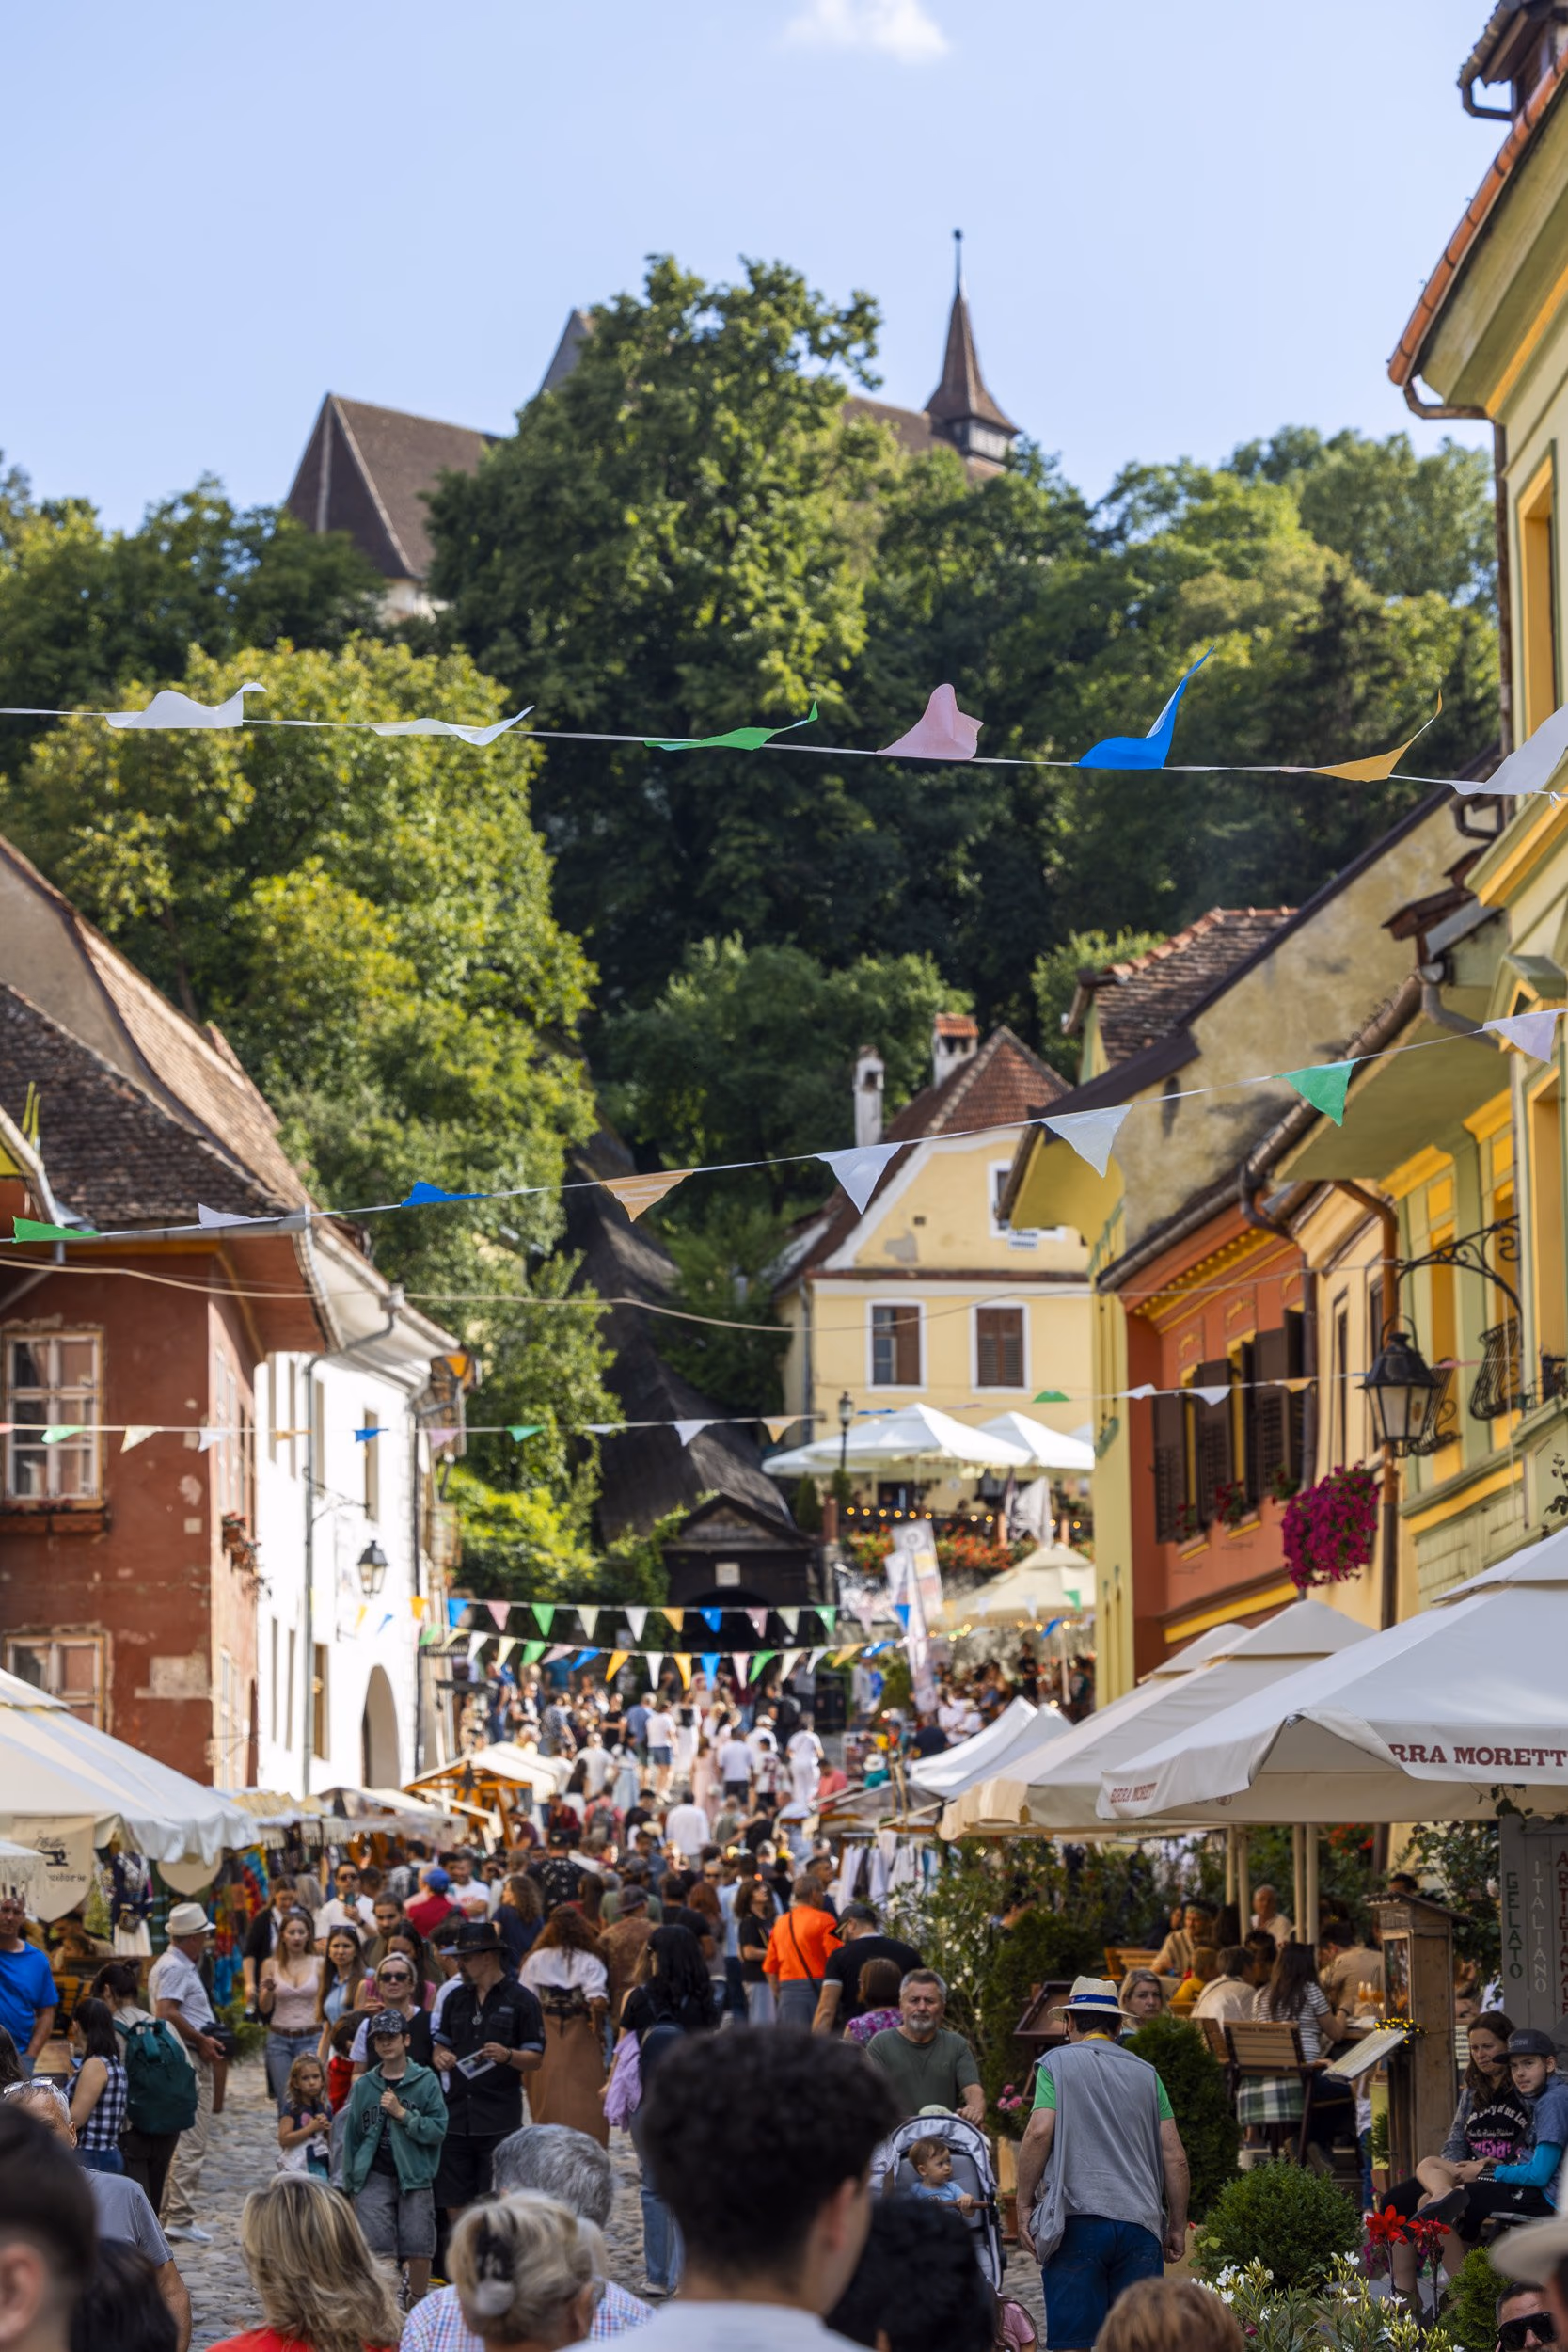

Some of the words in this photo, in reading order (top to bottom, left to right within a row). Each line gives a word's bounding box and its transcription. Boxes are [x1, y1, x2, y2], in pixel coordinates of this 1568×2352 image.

[1453, 1746, 1568, 1767] MORETT
[1506, 1871, 1523, 1979] GELATO
[1532, 1860, 1546, 1993] ITALIANO
